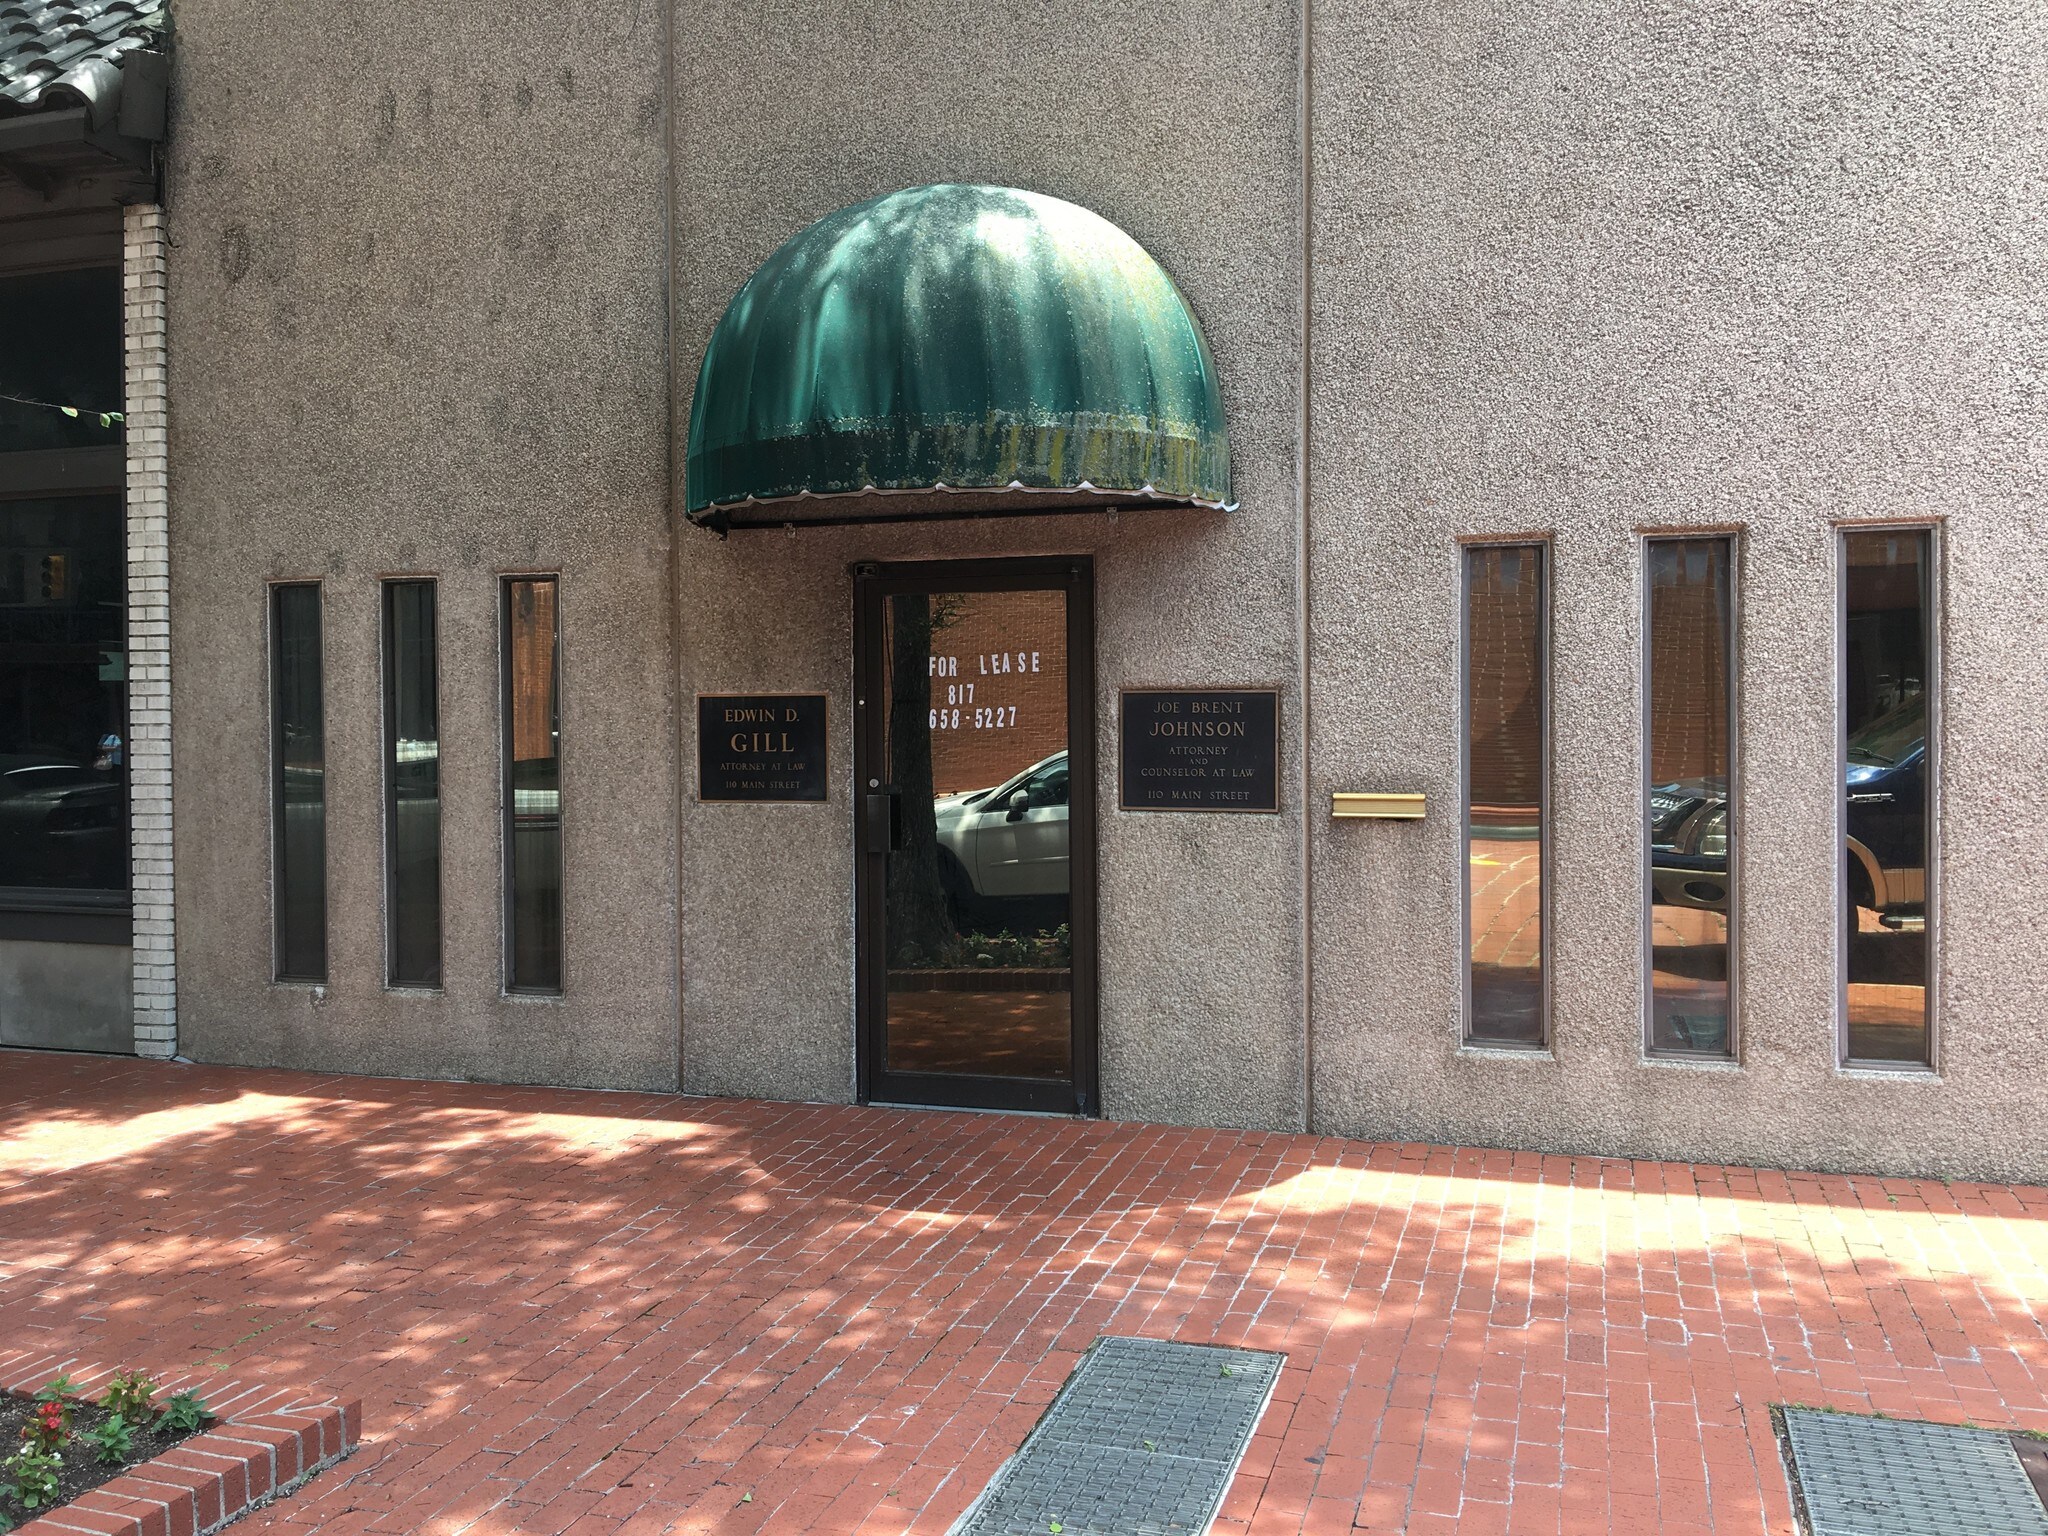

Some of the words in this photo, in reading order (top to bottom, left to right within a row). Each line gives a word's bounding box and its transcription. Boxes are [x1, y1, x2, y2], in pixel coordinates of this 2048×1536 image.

[929, 656, 957, 677] FOR
[980, 652, 1039, 675] LEASE
[948, 684, 974, 705] 817
[1154, 702, 1180, 713] JOE
[1192, 702, 1243, 713] BRENT
[725, 709, 775, 722] EDWIN
[786, 709, 799, 721] D.
[1150, 722, 1245, 737] JOHNSON
[731, 733, 795, 752] GILL
[1168, 746, 1229, 756] ATTORNEY
[719, 762, 766, 771] ATTORNEY
[770, 762, 782, 771] AT
[787, 762, 807, 771] LAW
[1189, 757, 1209, 766] AND
[1140, 767, 1207, 778] COUNSELOR
[1212, 768, 1227, 778] AT
[1232, 768, 1256, 778] LAW
[725, 780, 737, 789] 110
[741, 780, 766, 789] MAIN
[769, 780, 801, 789] STREET
[1147, 790, 1164, 799] 110
[1171, 790, 1202, 800] MAIN
[1209, 790, 1251, 801] STREET
